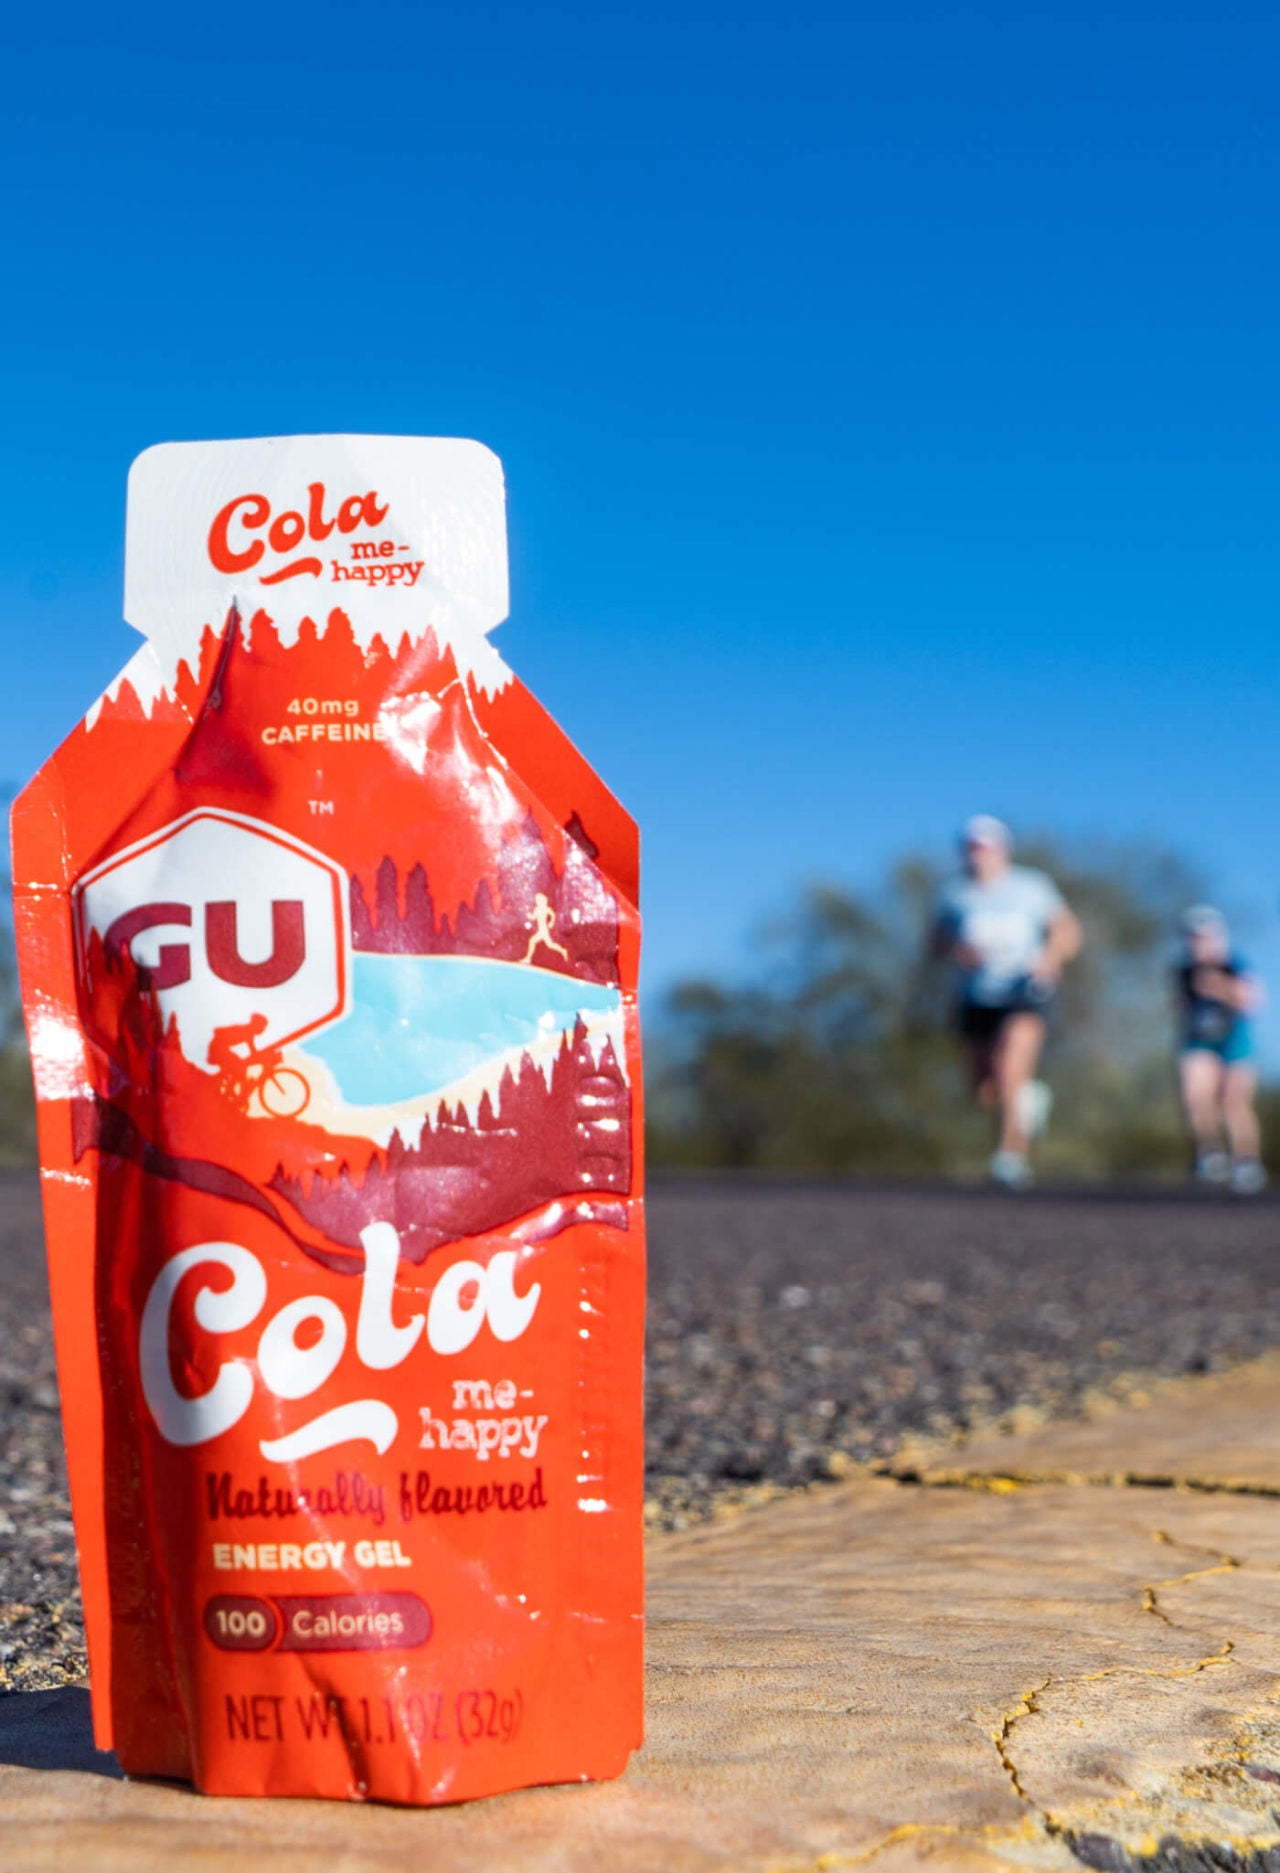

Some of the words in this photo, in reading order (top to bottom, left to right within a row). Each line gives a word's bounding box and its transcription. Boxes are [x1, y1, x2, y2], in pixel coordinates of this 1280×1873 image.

[207, 481, 390, 574] Cola
[350, 541, 410, 560] me-
[330, 560, 425, 586] happy
[286, 698, 359, 717] 40mg
[261, 723, 388, 745] CAFFEINE
[308, 799, 334, 816] TM
[104, 900, 306, 989] GU
[140, 1221, 540, 1446] Cola
[452, 1379, 534, 1410] me-
[419, 1408, 548, 1460] happy
[206, 1471, 386, 1526] Naturally
[399, 1467, 548, 1523] flavored
[213, 1541, 346, 1569] ENERGY
[354, 1540, 412, 1567] GEL
[216, 1609, 267, 1636] 100
[292, 1608, 404, 1636] Calories
[225, 1694, 284, 1742] NET
